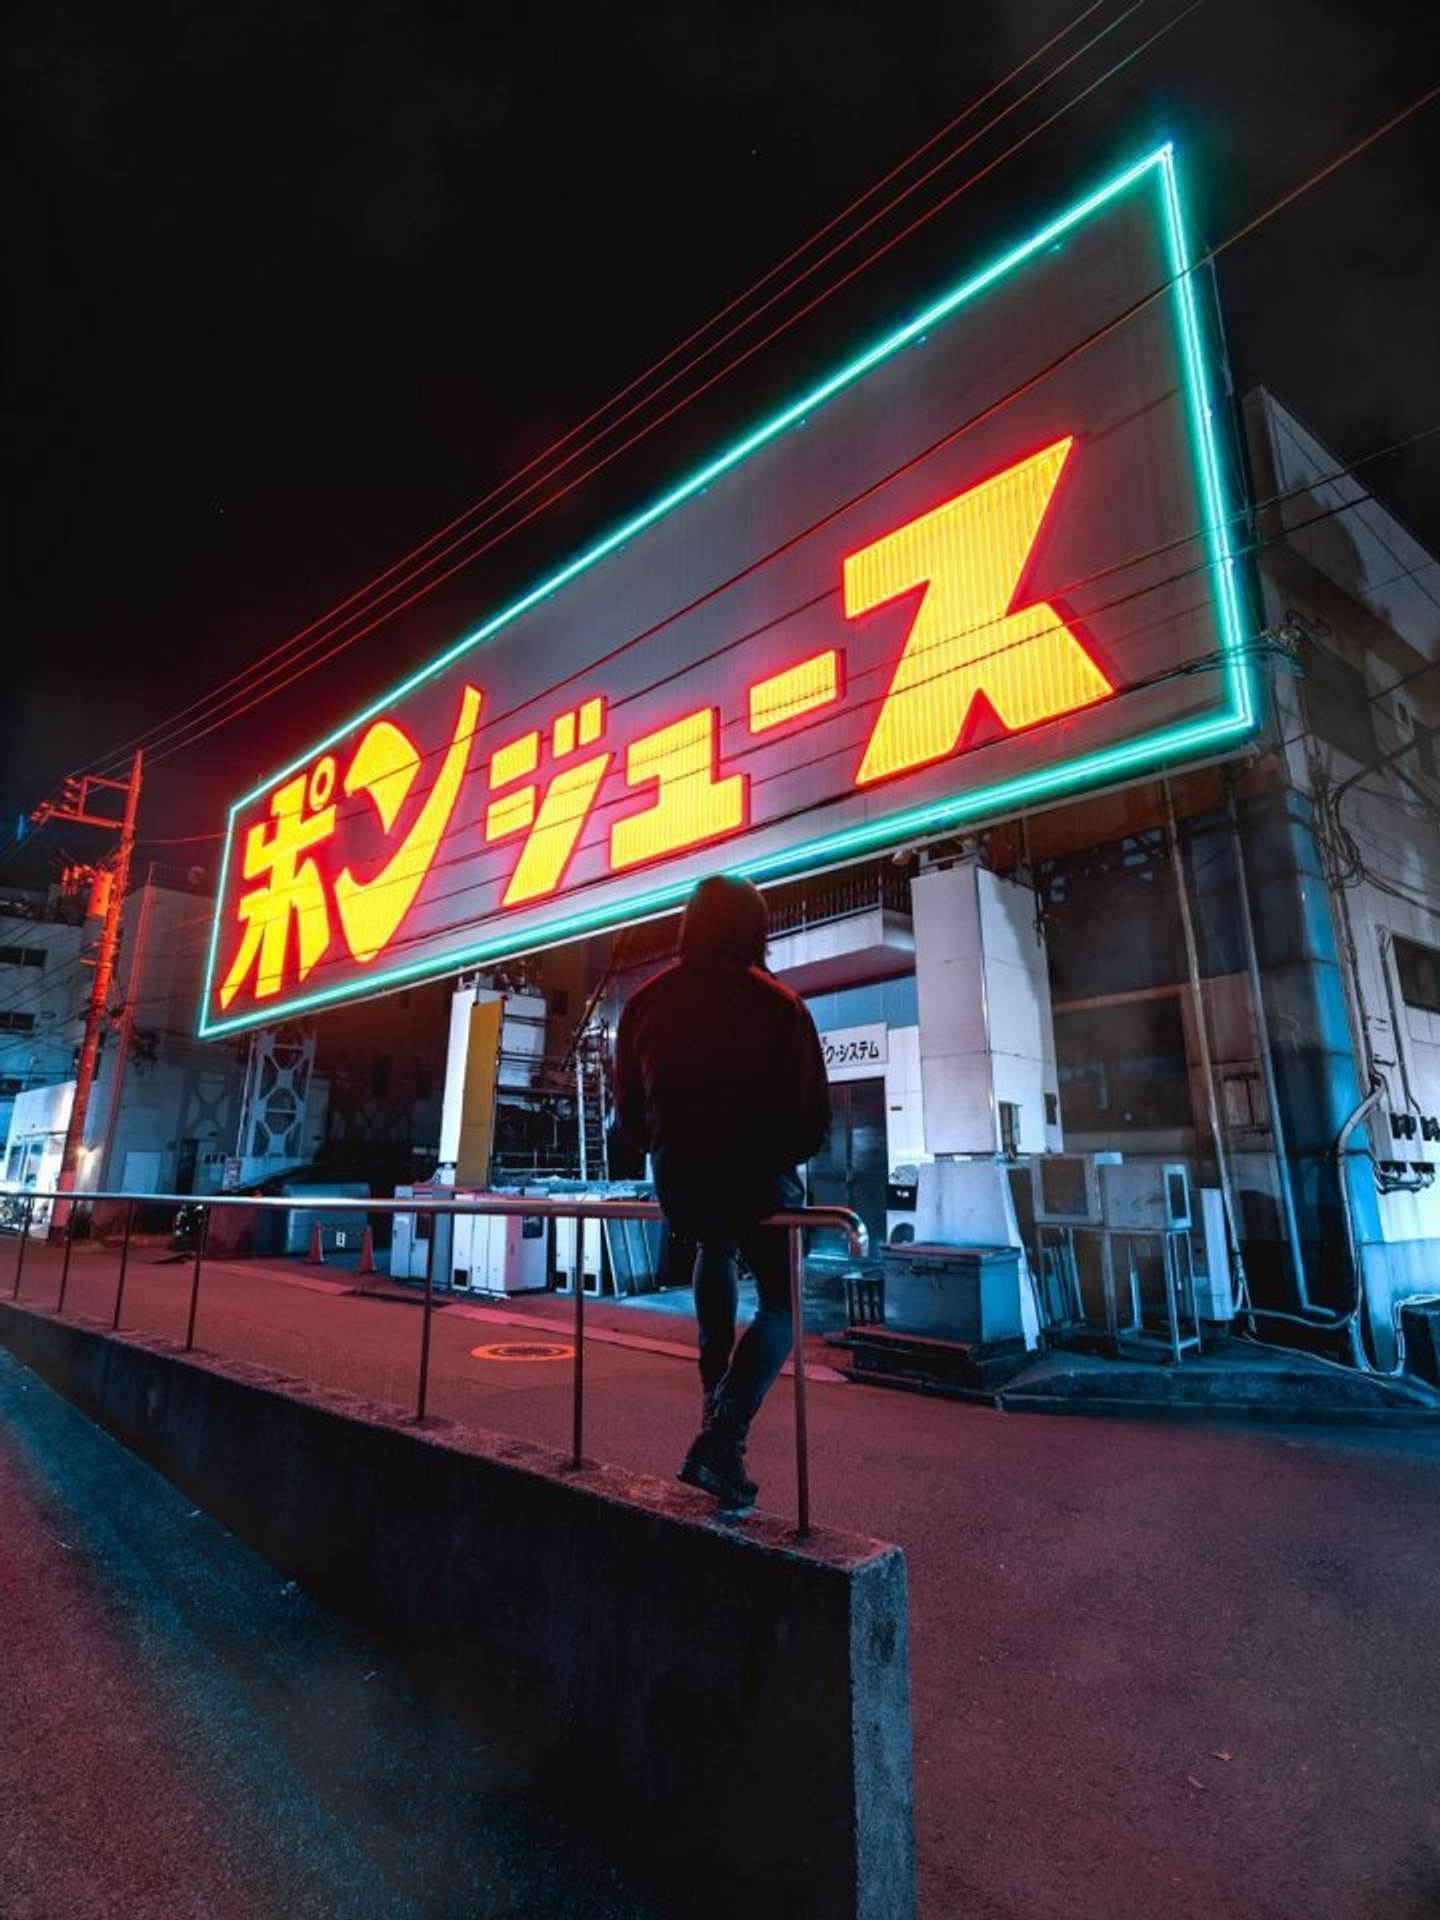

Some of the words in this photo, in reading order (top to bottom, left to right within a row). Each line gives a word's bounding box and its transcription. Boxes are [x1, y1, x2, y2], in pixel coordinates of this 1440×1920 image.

[219, 435, 1114, 1010] ポンジュース
[822, 1039, 879, 1065] ク・システム
